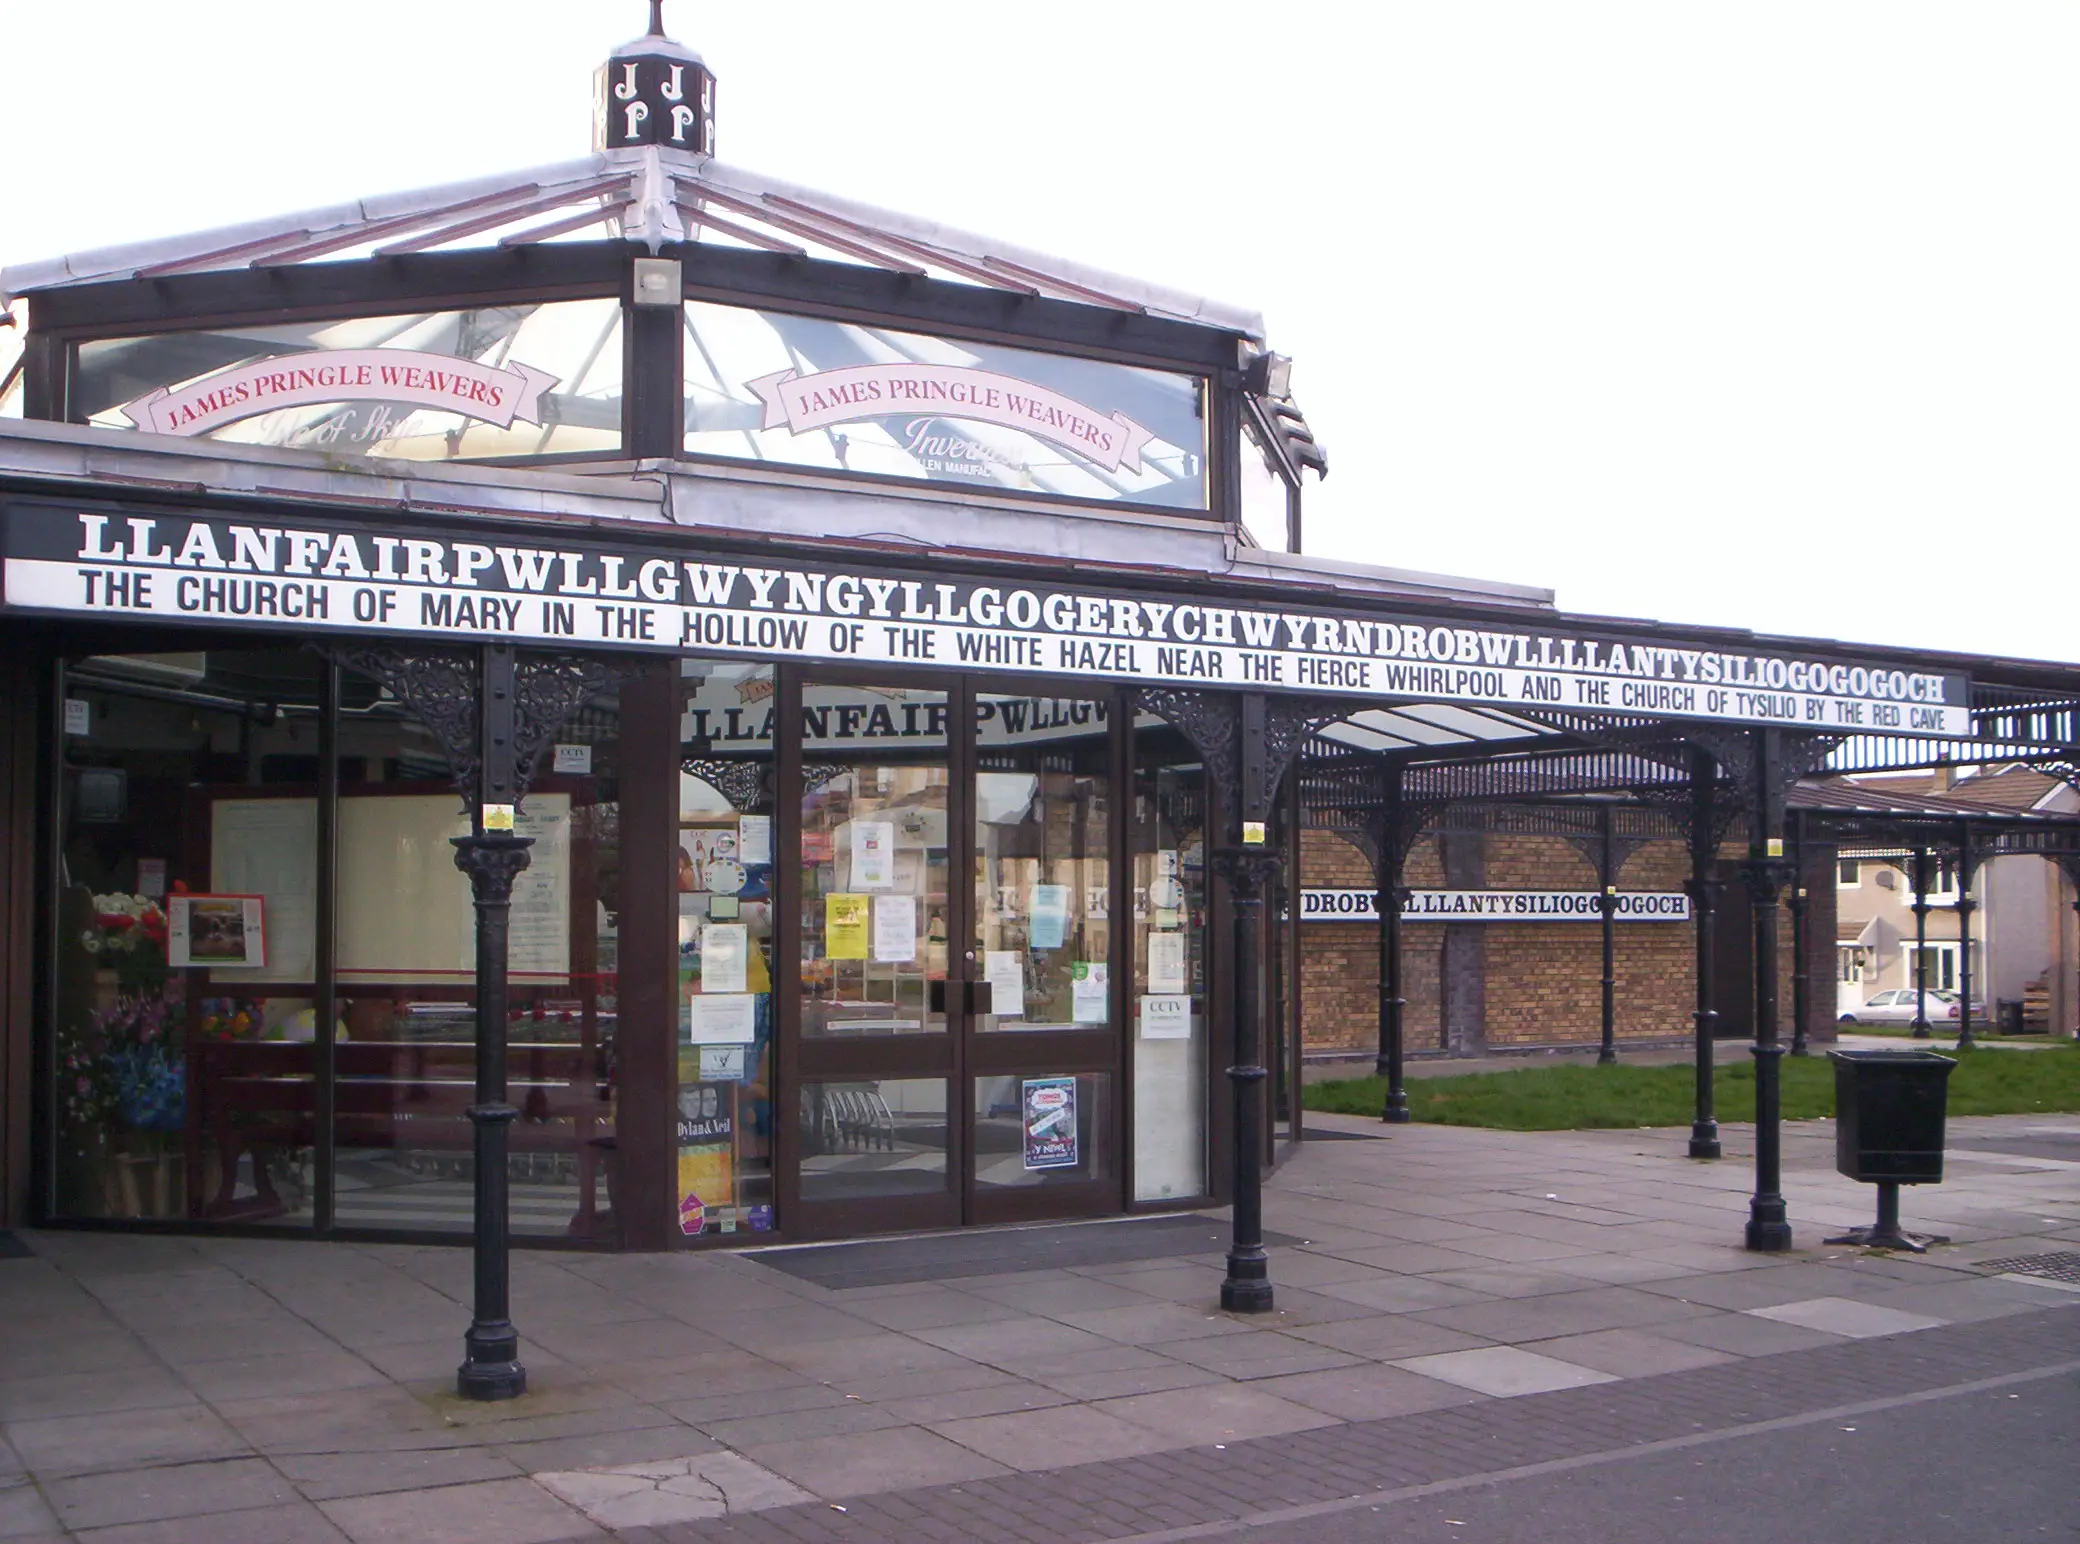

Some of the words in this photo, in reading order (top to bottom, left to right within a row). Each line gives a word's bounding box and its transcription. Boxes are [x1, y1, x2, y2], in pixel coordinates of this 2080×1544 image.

[614, 63, 639, 99] J
[661, 64, 684, 100] J
[625, 101, 649, 138] P
[670, 104, 694, 141] P
[169, 381, 250, 430] JAMES
[254, 365, 373, 398] PRINGLE
[381, 366, 505, 408] WEAVERS
[799, 380, 882, 417] JAMES
[889, 379, 1001, 408] PRINGLE
[1006, 393, 1113, 453] WEAVERS
[78, 569, 152, 610] THE
[176, 575, 329, 621] CHURCH
[353, 587, 396, 623] OF
[420, 590, 522, 633] MARY
[542, 603, 575, 635] IN
[596, 605, 656, 641] THE
[683, 611, 808, 650] HOLLOW
[829, 622, 864, 653] OF
[883, 626, 936, 659] THE
[956, 631, 1043, 666] WHITE
[1060, 639, 1142, 673] HAZEL
[1157, 647, 1223, 679] NEAR
[1239, 652, 1283, 682] THE
[1298, 657, 1371, 688] FIERCE
[1386, 663, 1508, 698] WHIRLPOOL
[1521, 675, 1562, 701] AND
[1575, 679, 1610, 705] THE
[1622, 681, 1695, 711] CHURCH
[1707, 690, 1729, 714] OF
[1736, 692, 1796, 719] TYSILIO
[1806, 699, 1826, 720] BY
[1836, 701, 1863, 725] THE
[1872, 704, 1901, 727] RED
[1910, 706, 1946, 731] CAVE
